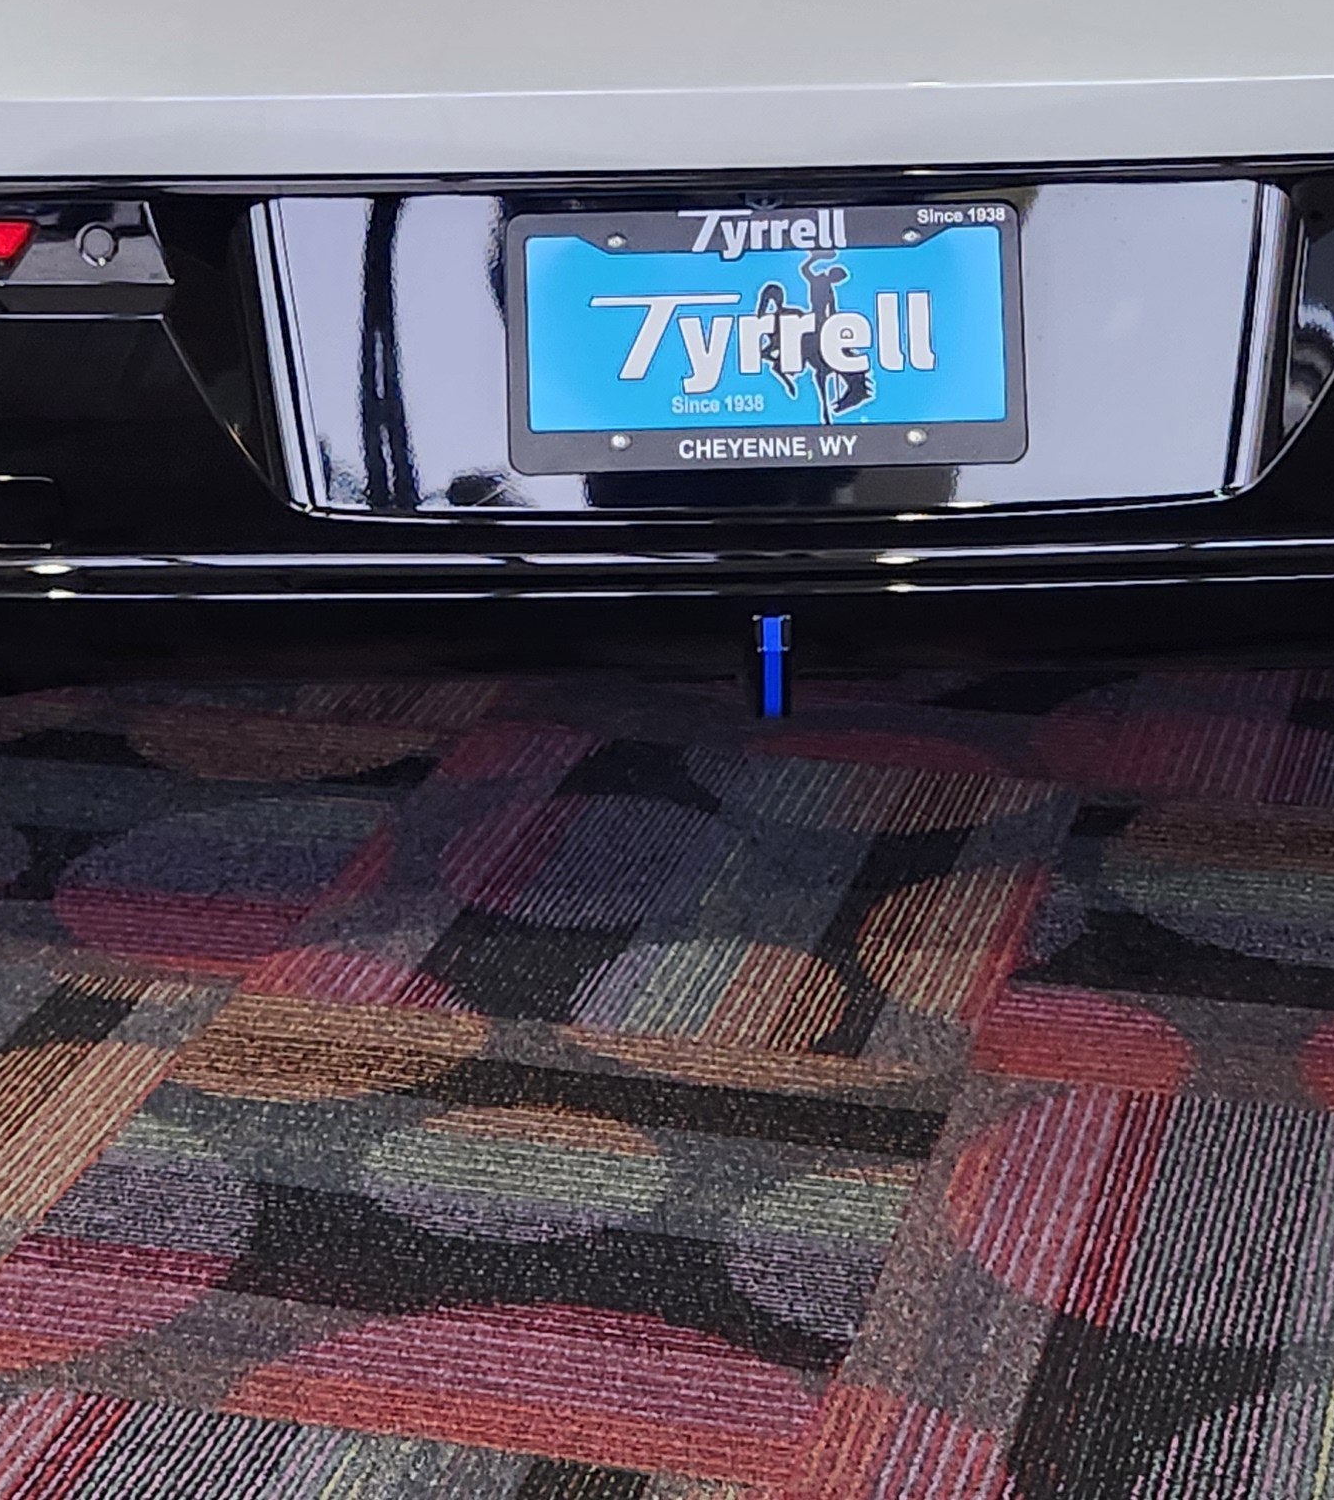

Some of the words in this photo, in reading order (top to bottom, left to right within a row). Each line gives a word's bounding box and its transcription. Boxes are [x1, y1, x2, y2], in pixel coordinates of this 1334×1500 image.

[916, 209, 963, 224] Since
[967, 207, 1006, 223] 1938
[677, 209, 847, 258] Tyrrell
[589, 292, 937, 394] Tyrrell
[671, 395, 720, 415] Since
[724, 394, 765, 413] 1938
[678, 437, 814, 460] CHEYENNE,
[819, 435, 858, 456] WY
